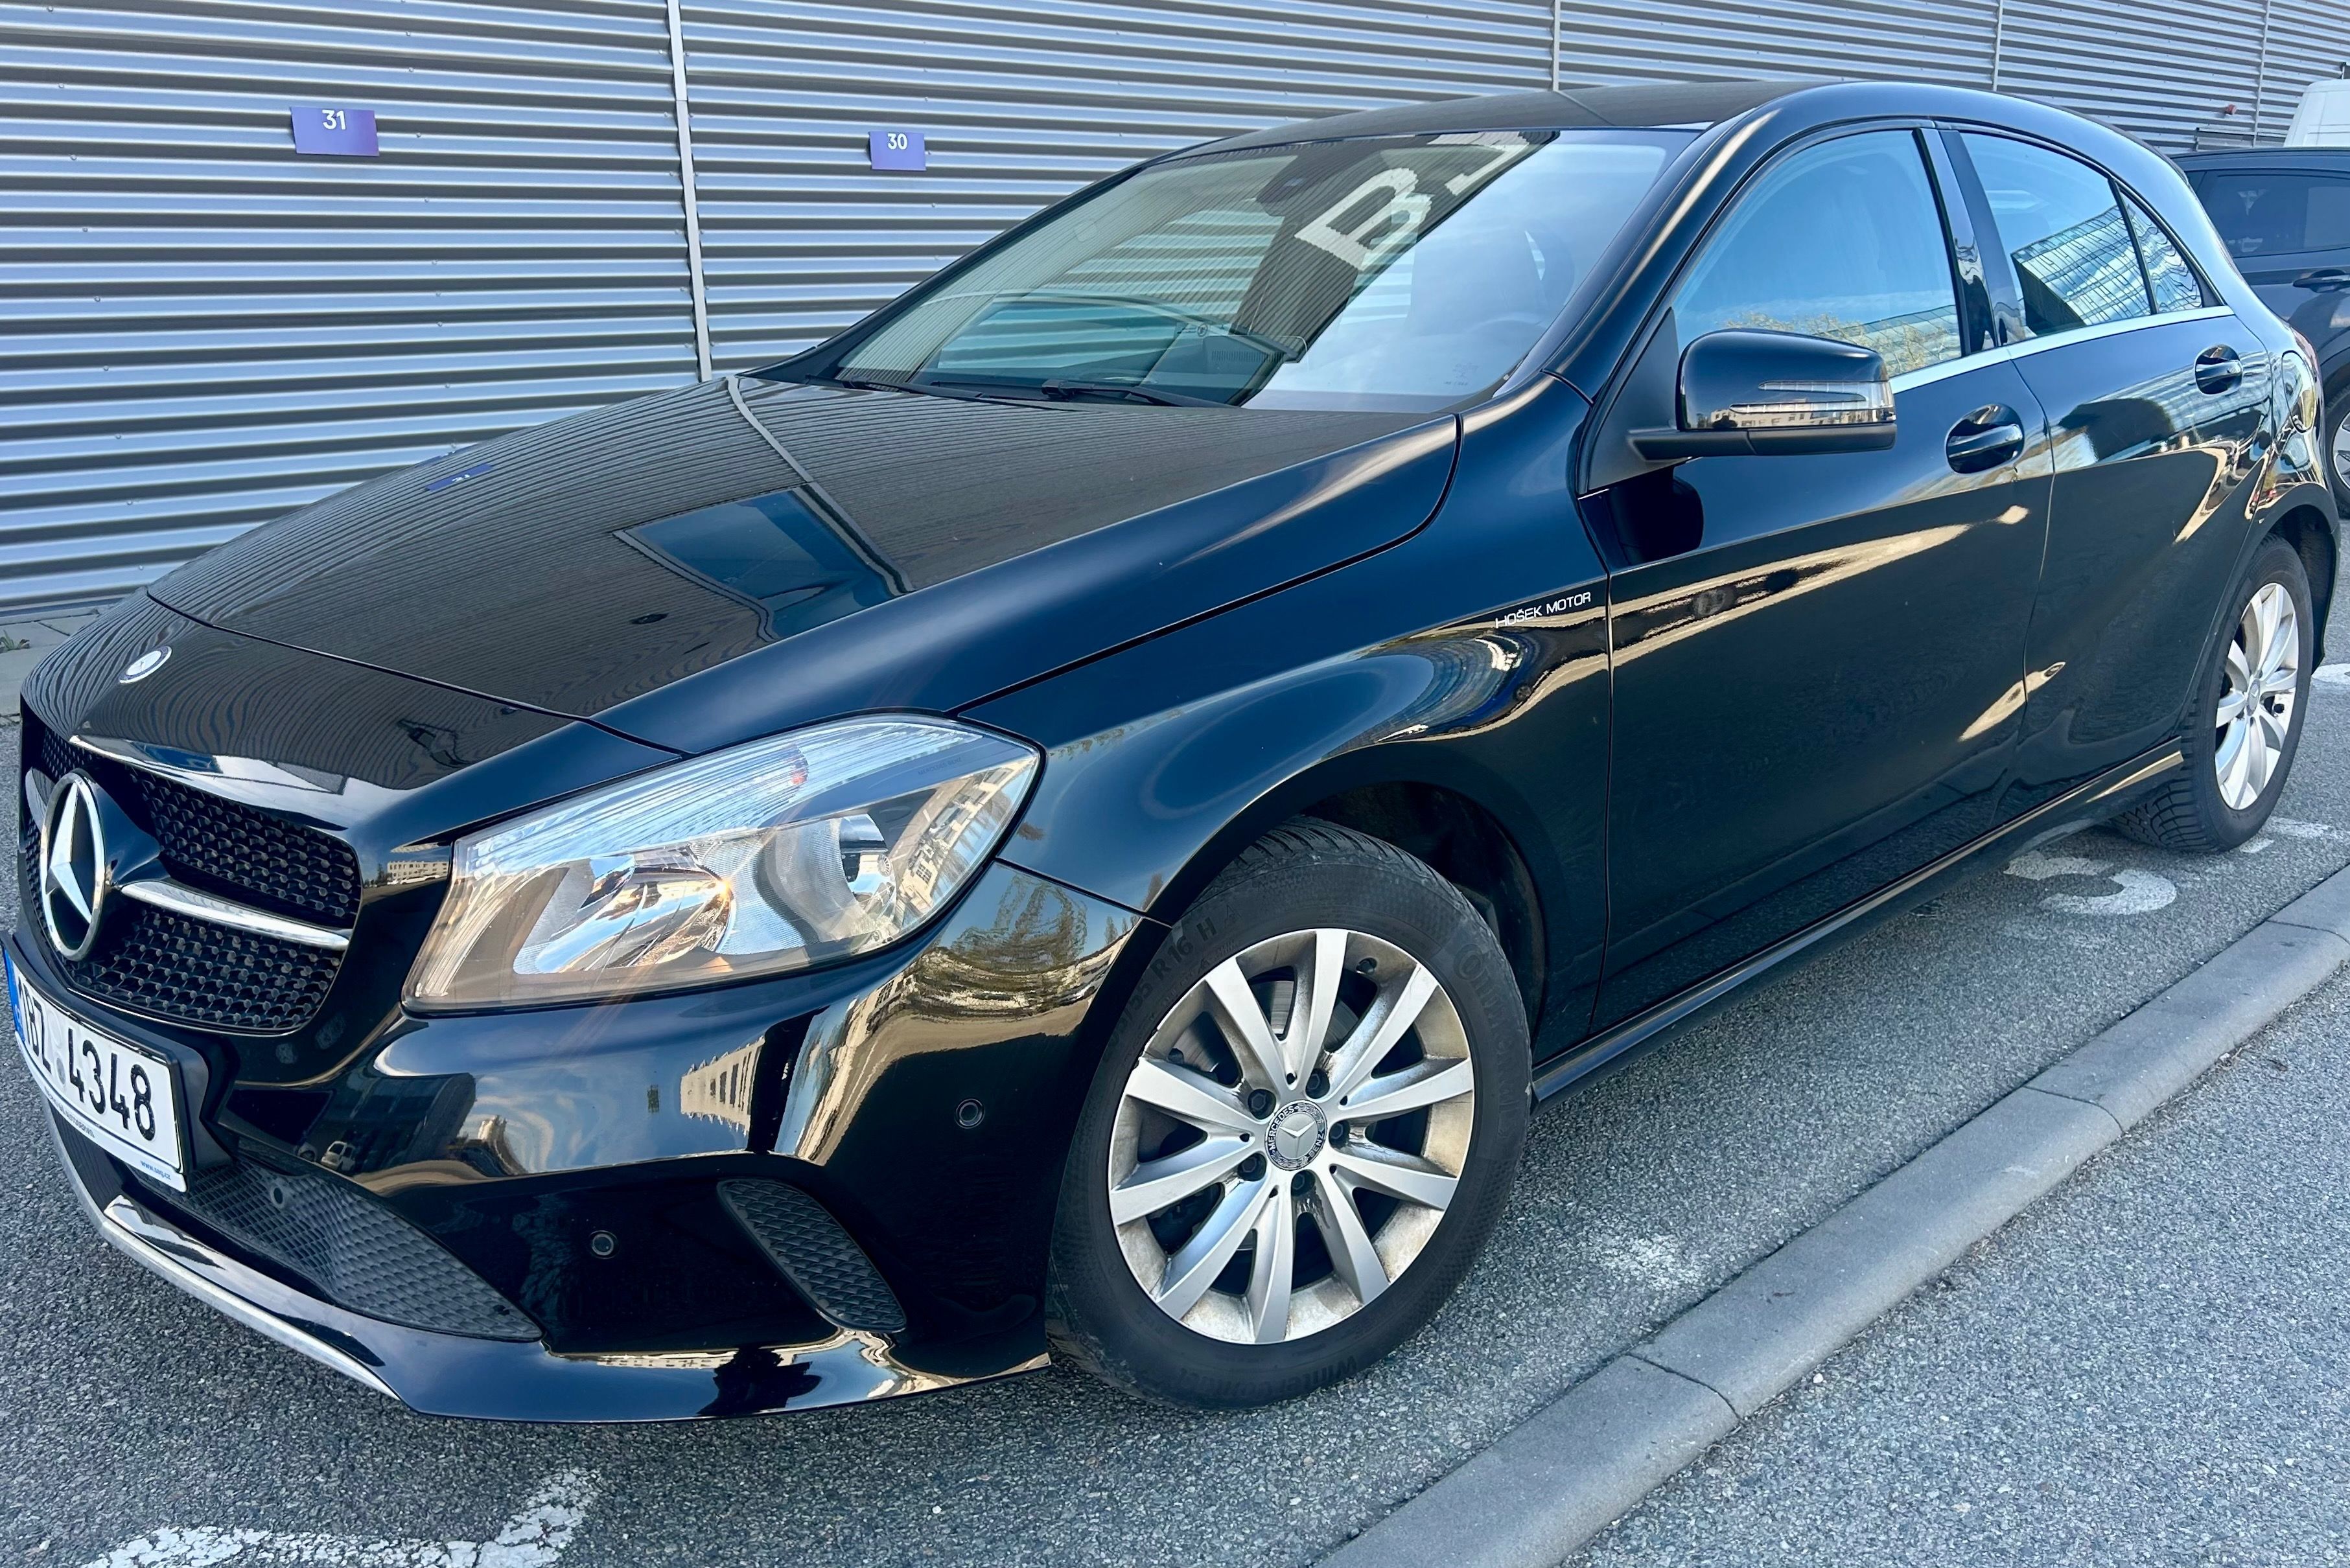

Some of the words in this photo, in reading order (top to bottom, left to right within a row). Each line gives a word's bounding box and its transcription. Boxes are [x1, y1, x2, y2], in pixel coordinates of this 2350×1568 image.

[322, 110, 346, 130] 31
[887, 133, 908, 150] 30
[1495, 605, 1542, 628] HOŠEK
[1546, 592, 1591, 614] MOTOR
[1196, 917, 1217, 941] H
[68, 1028, 156, 1141] 4348
[1267, 1105, 1295, 1150] MERCEDES
[1309, 1131, 1325, 1158] BENZ
